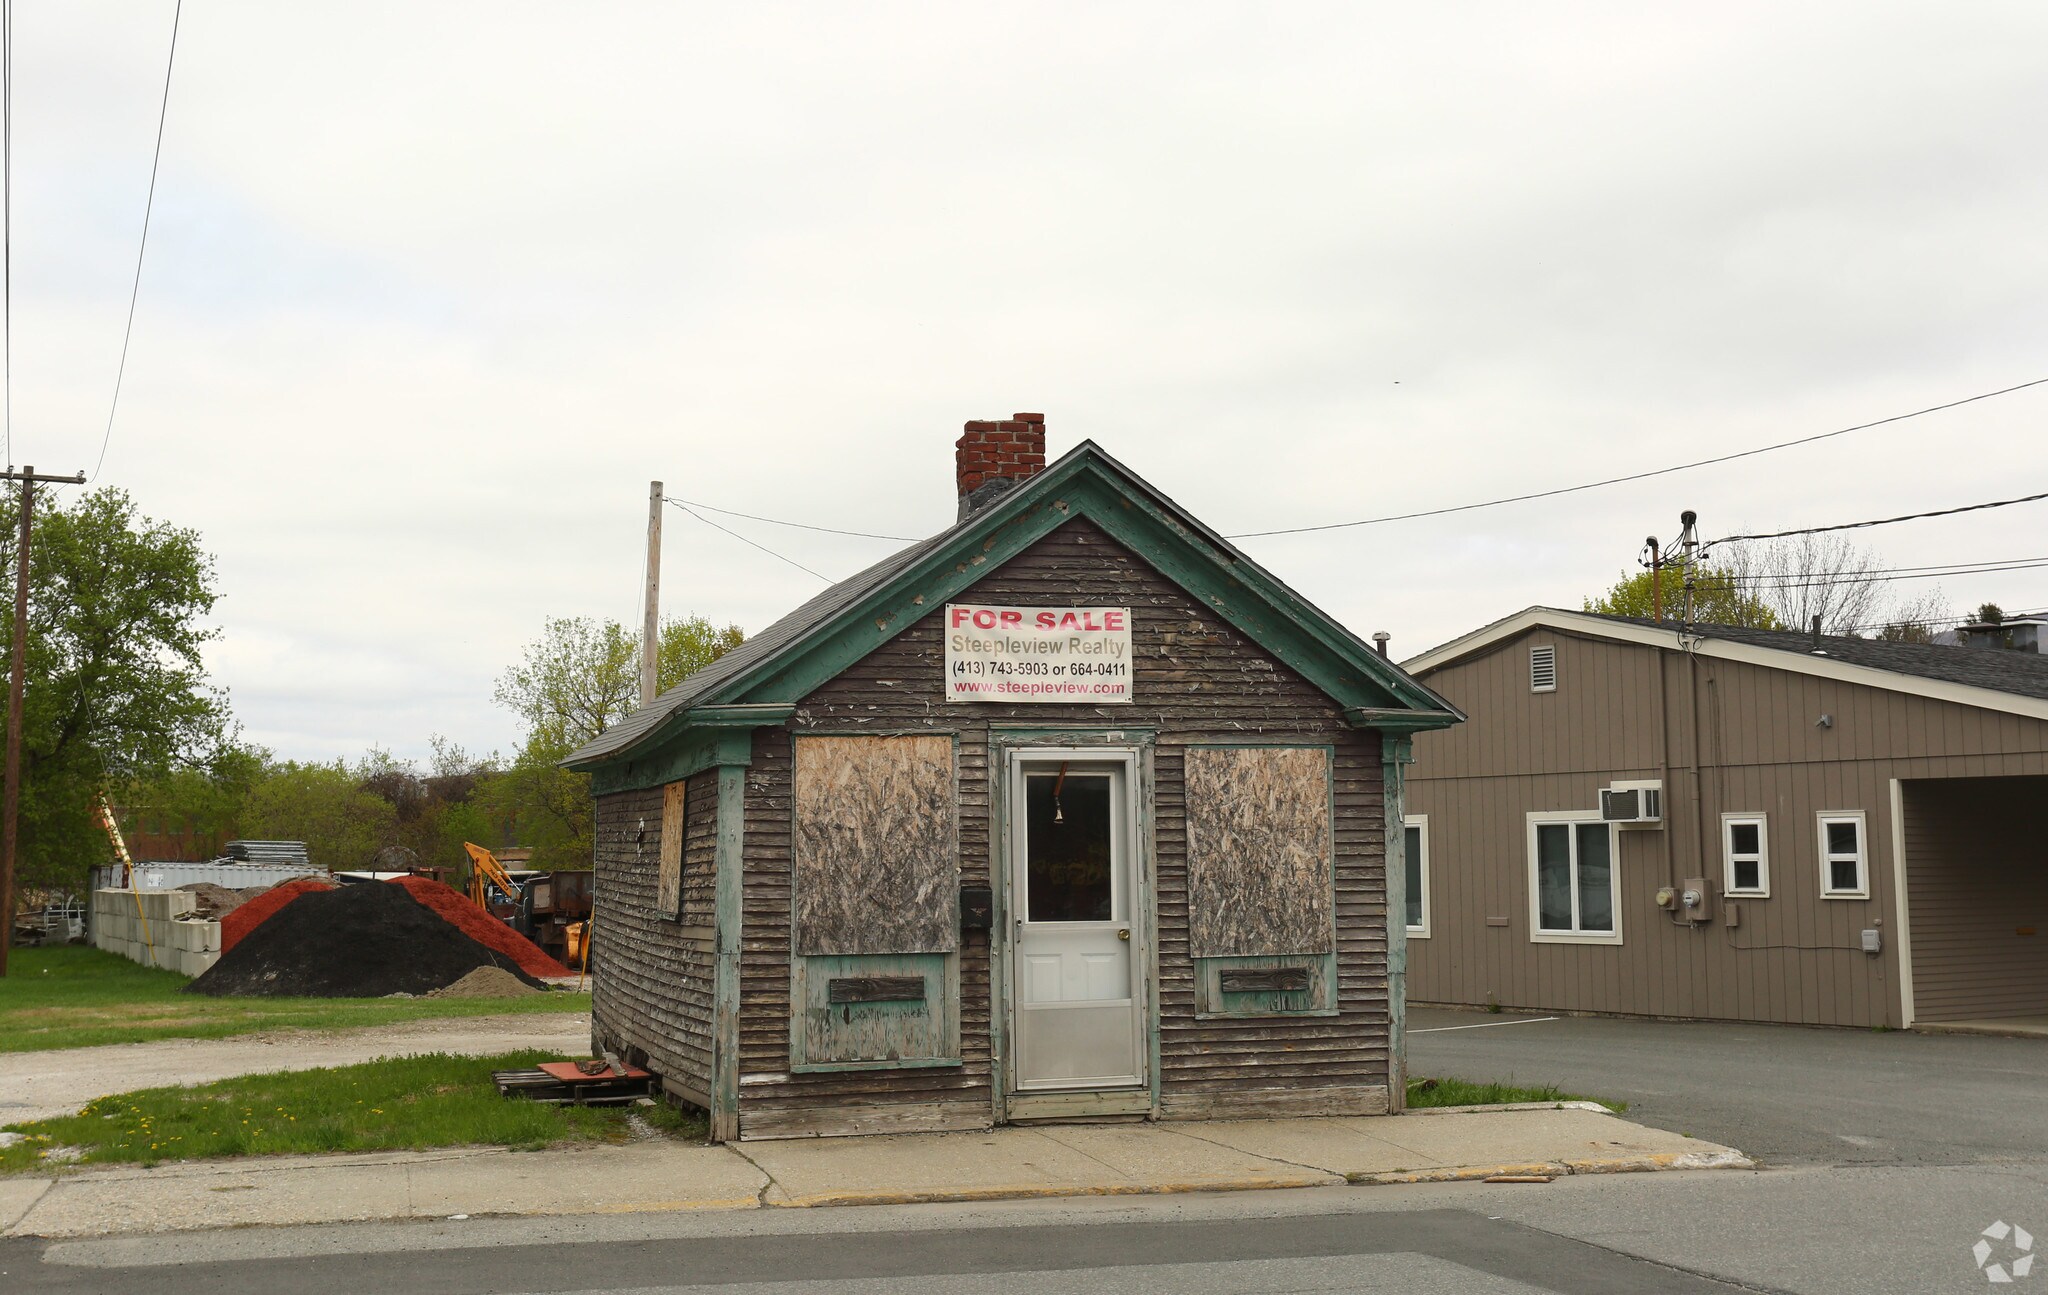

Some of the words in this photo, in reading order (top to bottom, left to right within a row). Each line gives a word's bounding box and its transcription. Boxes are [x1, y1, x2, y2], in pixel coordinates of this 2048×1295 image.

[951, 608, 1023, 631] FOR
[1034, 611, 1125, 632] SALE
[952, 634, 1063, 657] Steepleview
[1069, 637, 1125, 659] Realty
[952, 660, 985, 677] (413)
[989, 661, 1049, 676] 743-5903
[1052, 664, 1066, 676] or
[1070, 662, 1126, 676] 664-0411
[954, 681, 1125, 696] www.steepleview.com
